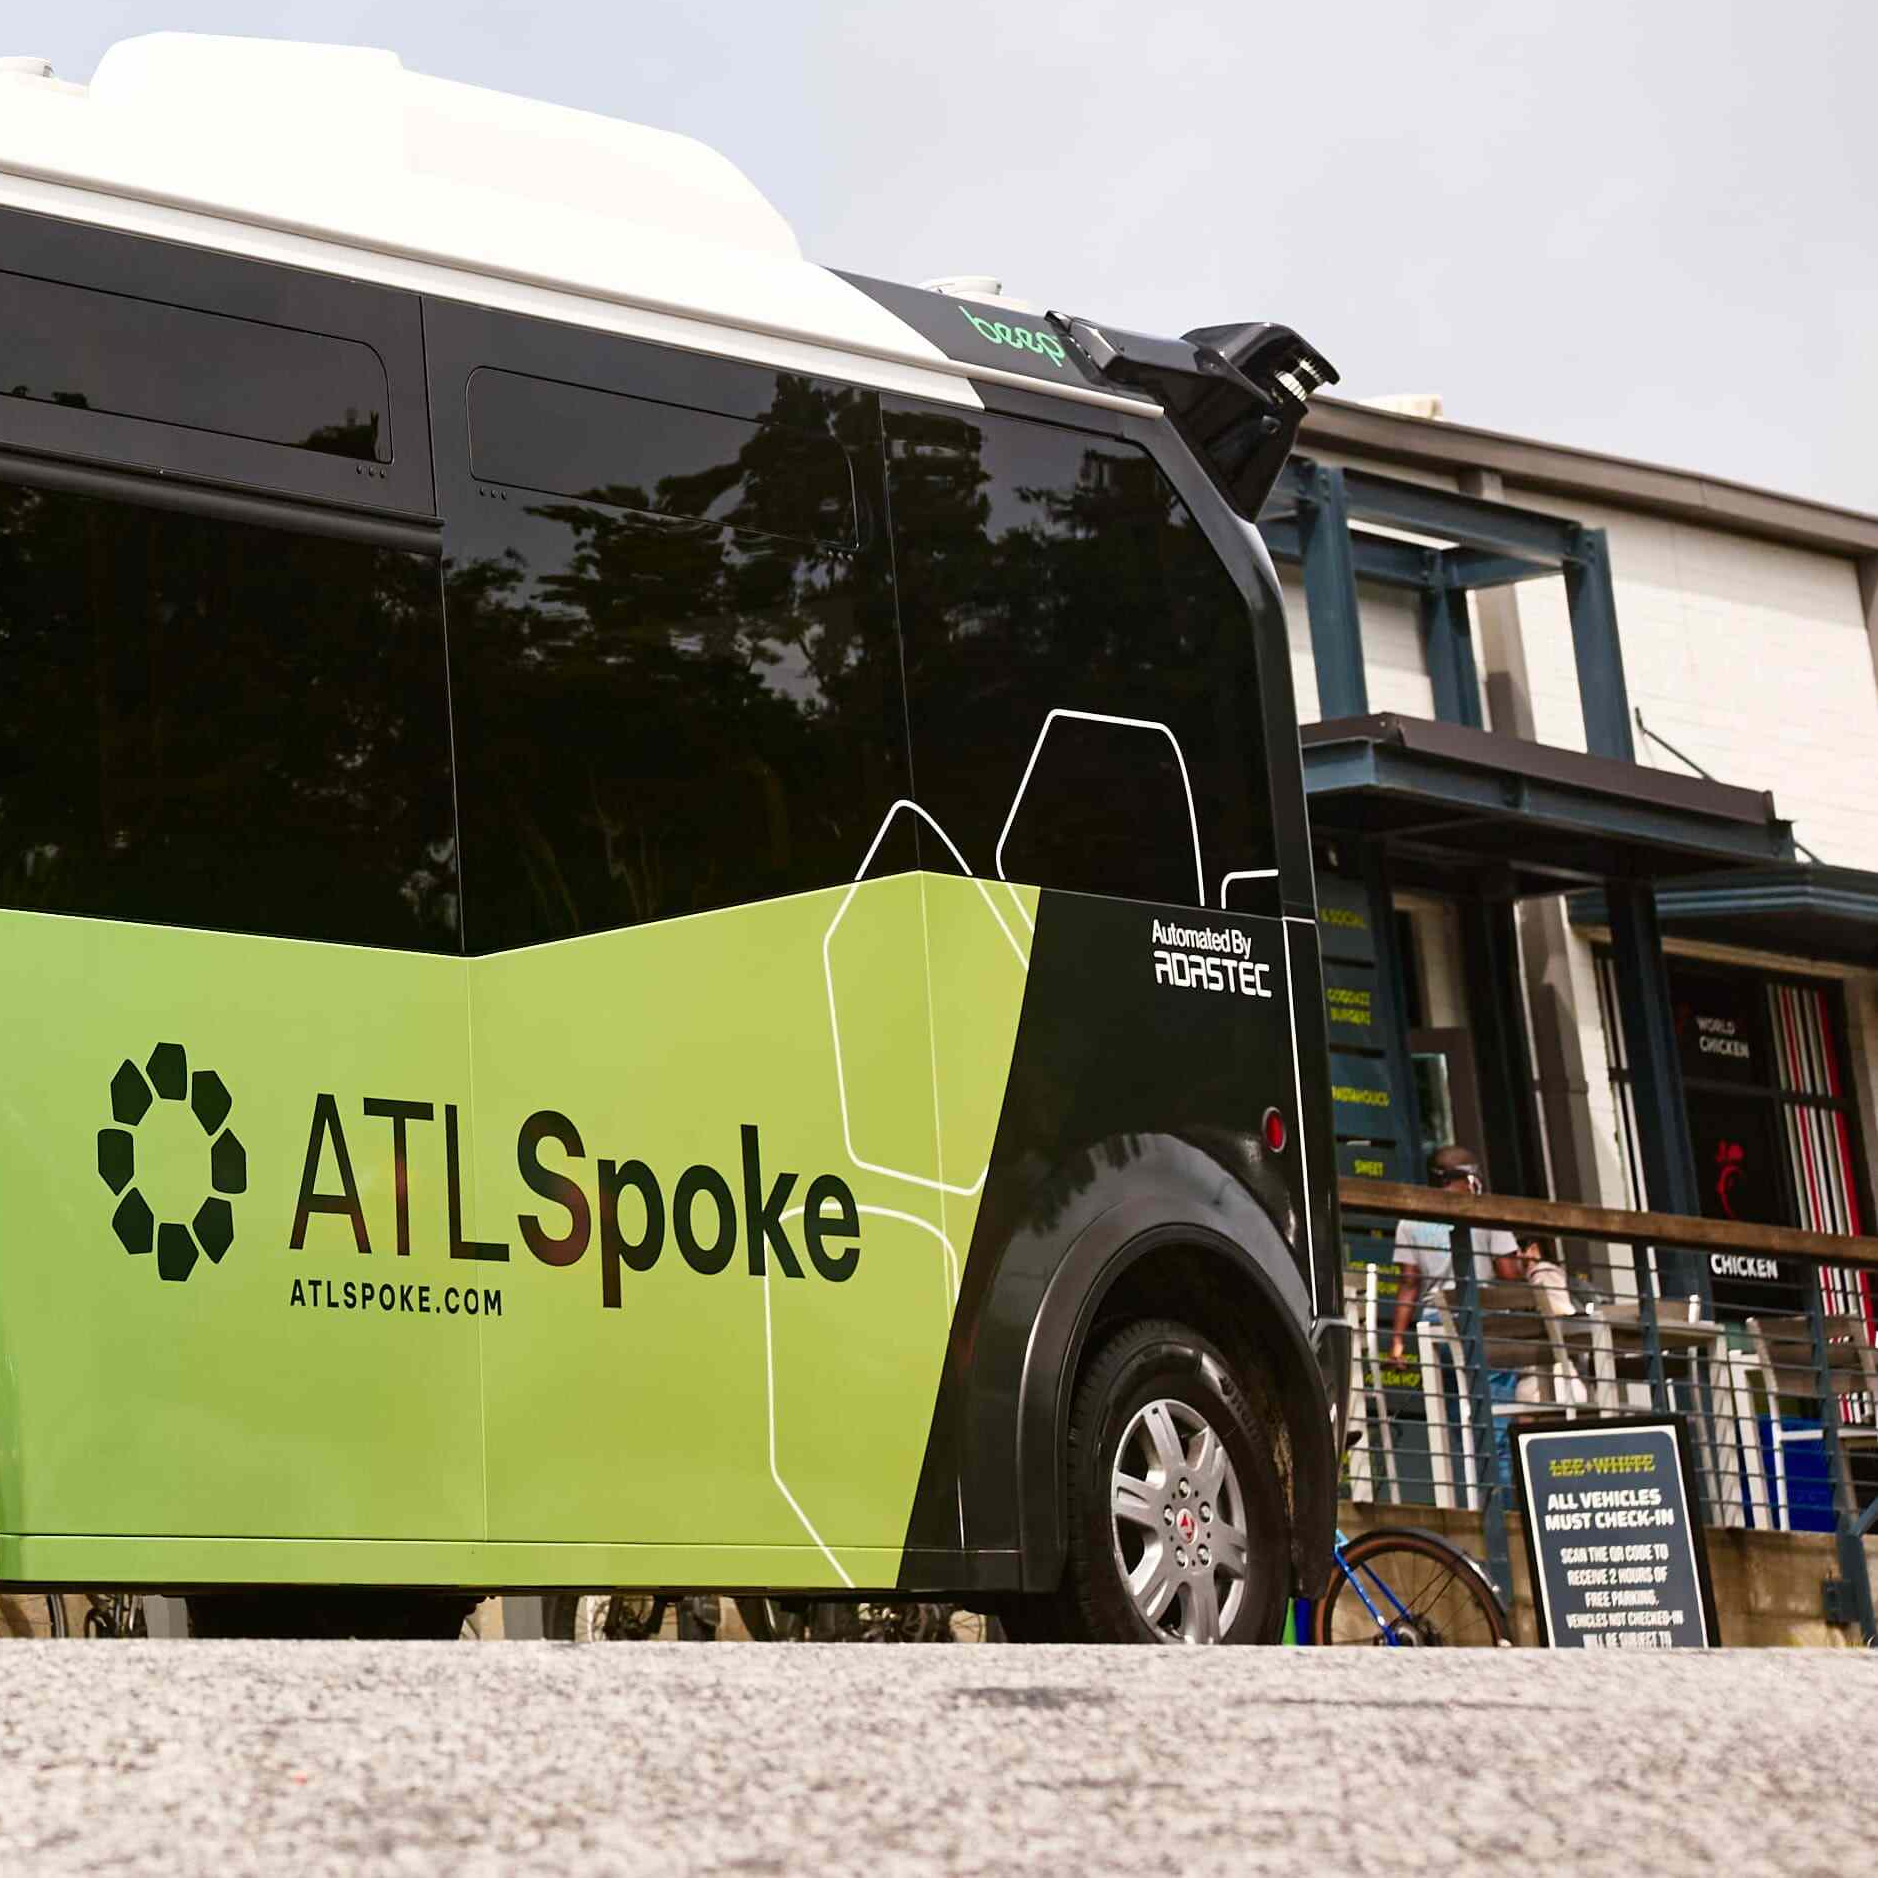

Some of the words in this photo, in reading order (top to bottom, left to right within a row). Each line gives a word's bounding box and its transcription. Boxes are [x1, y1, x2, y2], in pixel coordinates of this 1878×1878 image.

[958, 305, 1065, 368] beep
[1152, 919, 1230, 953] Automated
[1233, 929, 1251, 960] By
[1153, 950, 1272, 998] ADASTEC
[1699, 1035, 1749, 1059] CHICKEN
[289, 1093, 861, 1309] ATLSpoke
[1710, 1253, 1779, 1280] CHICKEN
[289, 1279, 503, 1317] ATLSPOKE.COM
[1548, 1491, 1578, 1511] ALL
[1579, 1488, 1662, 1509] VEHICLES
[1544, 1512, 1591, 1531] MUST
[1594, 1508, 1675, 1529] CHECK-IN
[1560, 1547, 1588, 1564] SCAN
[1588, 1546, 1610, 1563] THE
[1625, 1544, 1654, 1561] CODE
[1653, 1543, 1669, 1560] TO
[1567, 1568, 1608, 1586] RECEIVE
[1608, 1568, 1619, 1585] 2
[1618, 1566, 1653, 1584] HOURS
[1653, 1565, 1668, 1583] OF
[1585, 1591, 1611, 1608] FREE
[1566, 1612, 1608, 1629] VEHICLES
